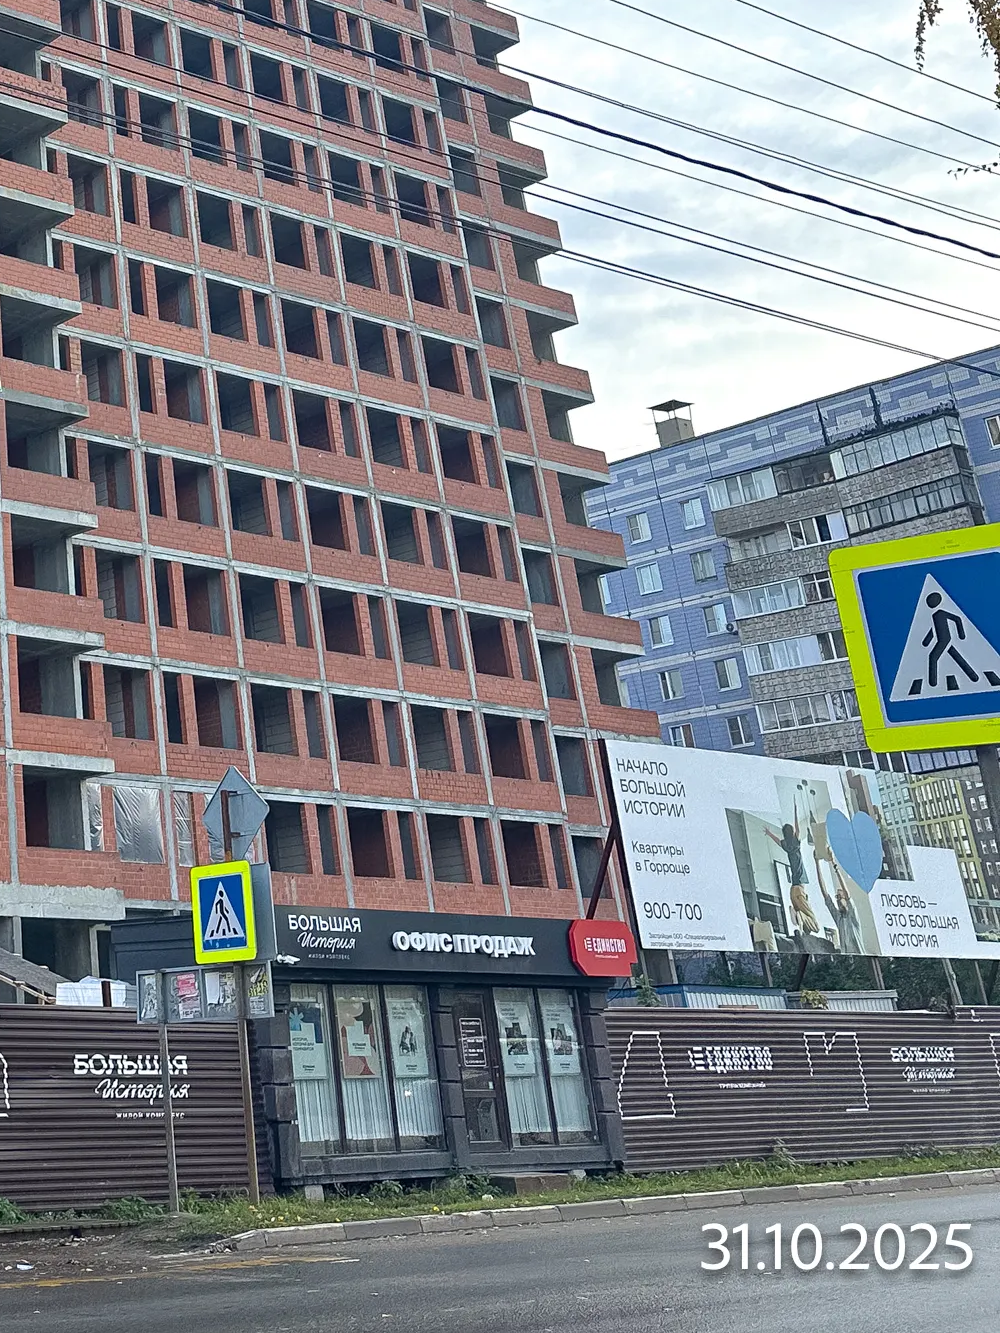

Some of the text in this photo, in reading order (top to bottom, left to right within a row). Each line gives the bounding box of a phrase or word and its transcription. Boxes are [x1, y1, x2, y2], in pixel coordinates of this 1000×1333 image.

[616, 758, 668, 776] НАЧАЛО
[620, 779, 686, 797] БОЛЬШОЙ
[623, 799, 686, 818] ИСТОРИИ
[631, 840, 685, 857] Квартиры
[635, 860, 690, 876] в Горроще
[881, 894, 927, 909] ЛЮБОВЬ
[643, 901, 703, 921] 900-700
[288, 914, 362, 933] БОЛЬШАЯ
[885, 913, 960, 930] ЭТО БОЛЬШАЯ
[297, 931, 357, 953] История
[392, 931, 537, 958] ОФИС ПРОДАЖ
[592, 937, 627, 953] ЕДИНСТВО
[889, 933, 940, 948] ИСТОРИЯ
[890, 1047, 956, 1062] БОЛЬШАЯ
